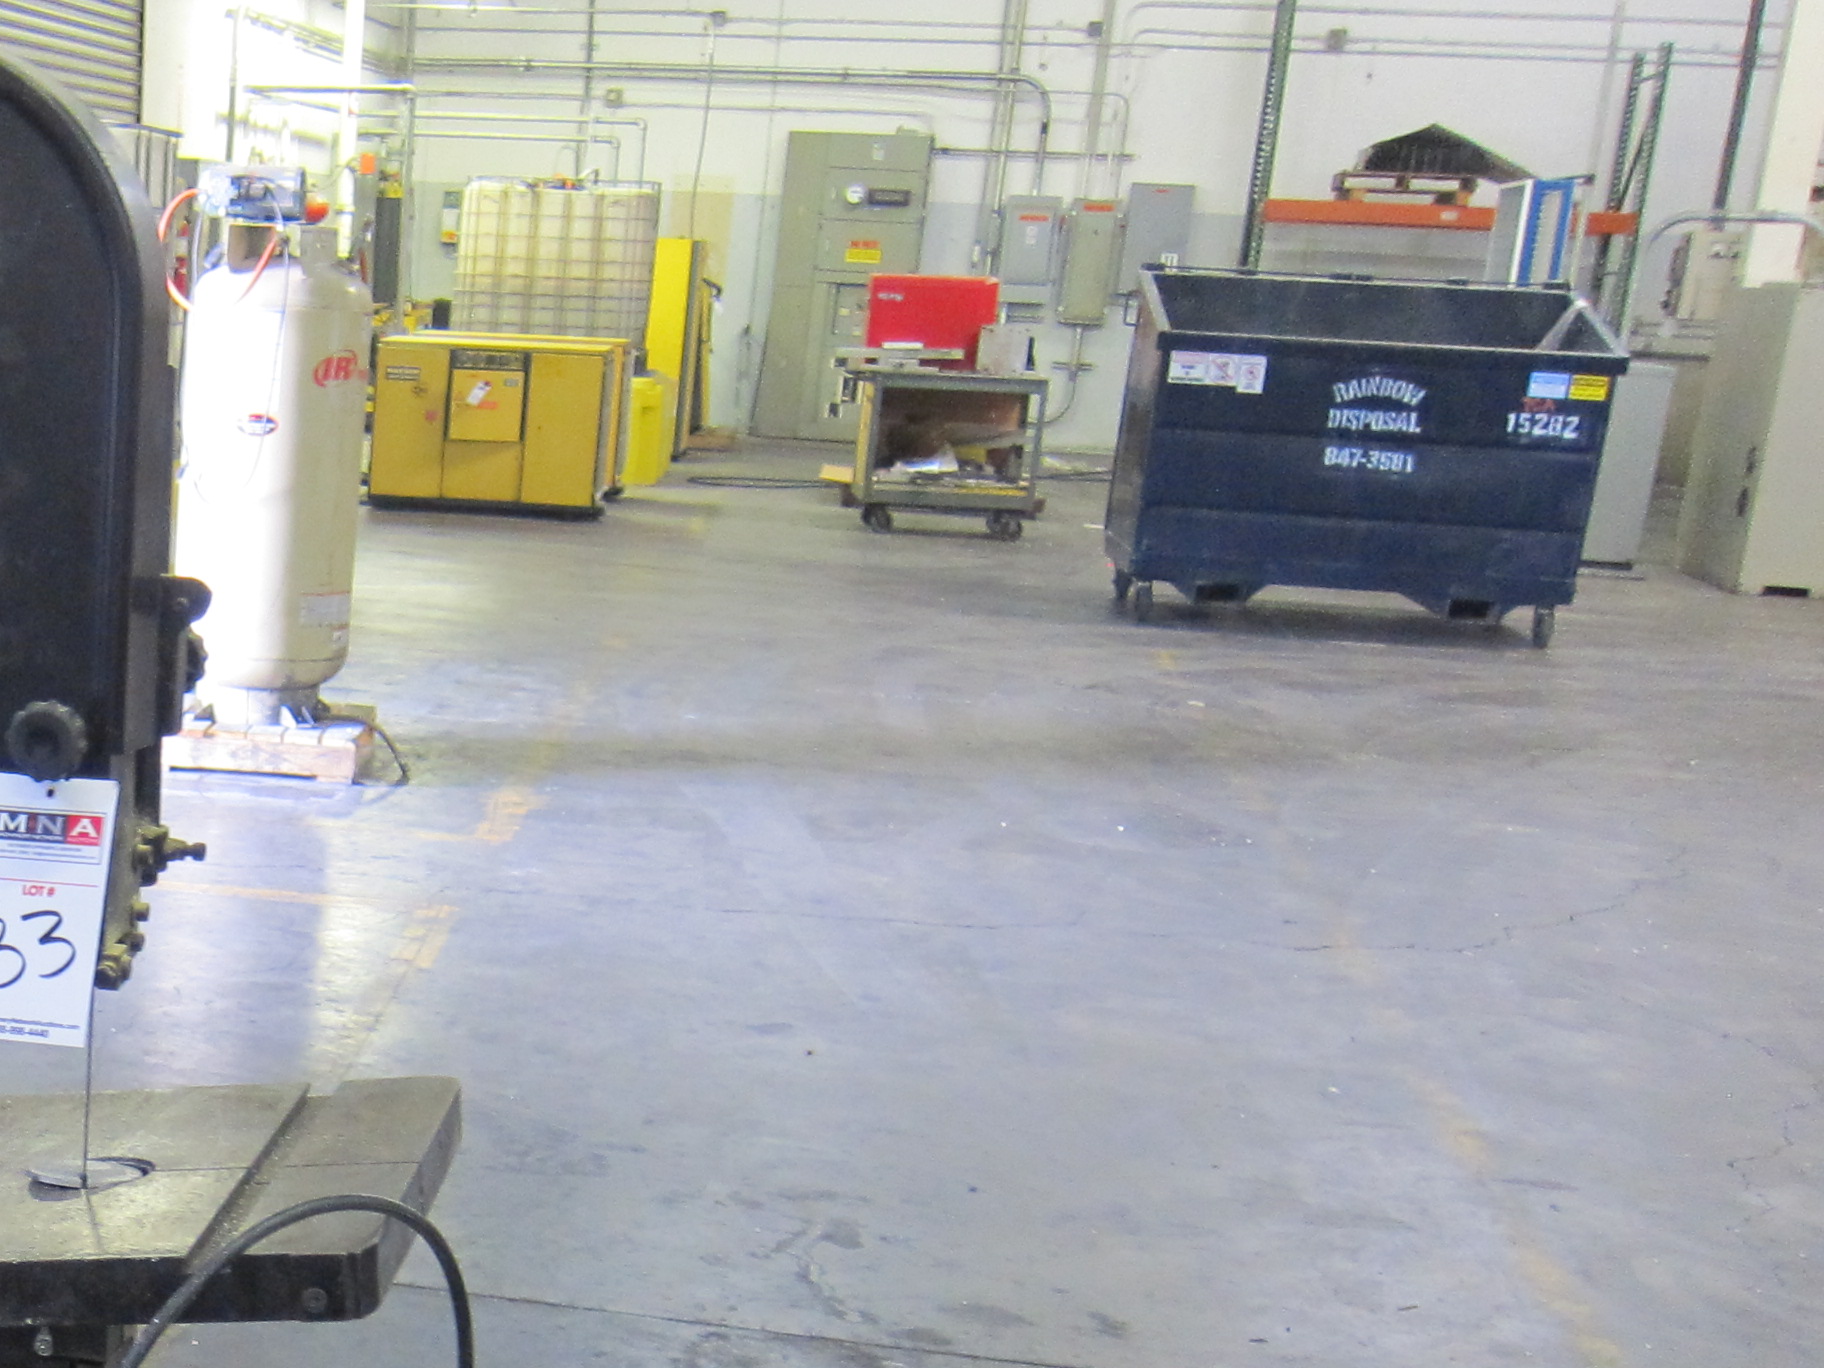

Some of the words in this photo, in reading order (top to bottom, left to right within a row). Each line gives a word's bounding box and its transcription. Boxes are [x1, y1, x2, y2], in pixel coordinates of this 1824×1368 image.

[1333, 376, 1427, 406] RAINBOW
[1328, 408, 1422, 433] DISPOSAL
[22, 884, 44, 896] LOT
